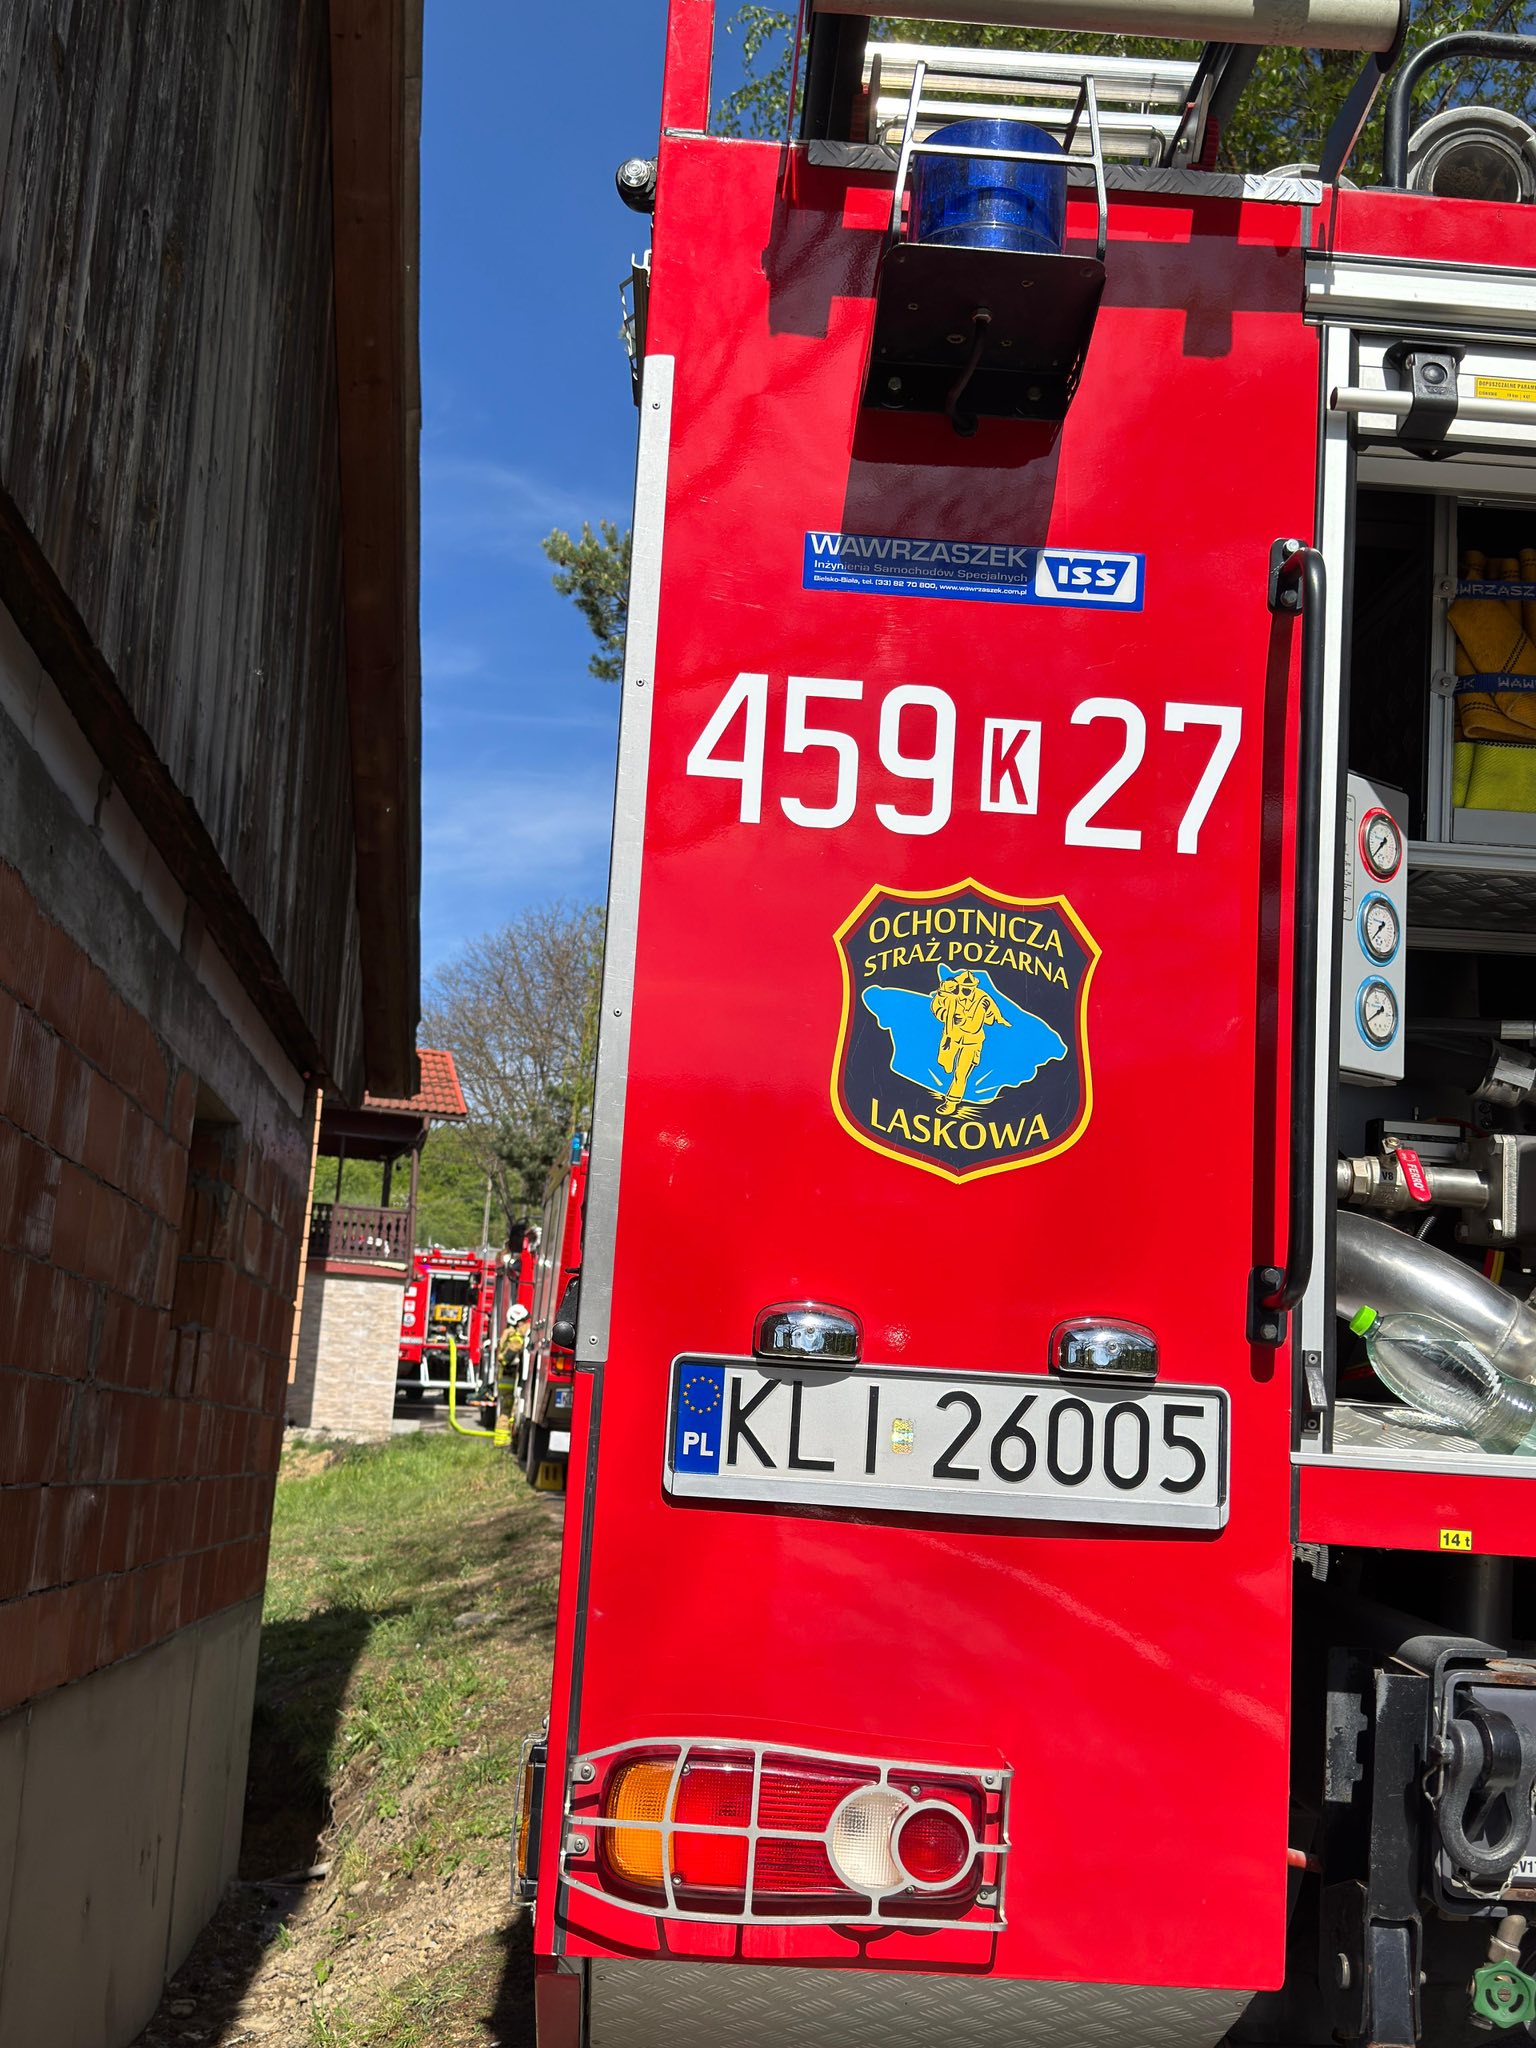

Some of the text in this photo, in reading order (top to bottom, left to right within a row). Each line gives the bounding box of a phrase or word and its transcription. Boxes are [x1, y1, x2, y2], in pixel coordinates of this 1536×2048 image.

[810, 534, 1028, 569] WAWRZASZEK
[814, 559, 1028, 583] Inżynieria Samochodów Specjalnych
[1058, 565, 1116, 588] ISS
[875, 579, 891, 587] (33)
[939, 584, 1028, 595] www.wawrzaszek.com.pl
[1457, 583, 1536, 597] WRZASZ
[1497, 676, 1536, 690] WAW
[686, 672, 1242, 854] 459 K 27
[868, 908, 1064, 957] OCHOTNICZA
[863, 936, 1069, 989] STRAŻ POŻARNA
[871, 1097, 1050, 1150] LASKOWA
[1382, 1171, 1394, 1181] V8
[682, 1432, 714, 1458] PL
[726, 1376, 1207, 1492] KLI 26005
[1443, 1533, 1470, 1547] 14 t
[1519, 1860, 1536, 1873] V1
